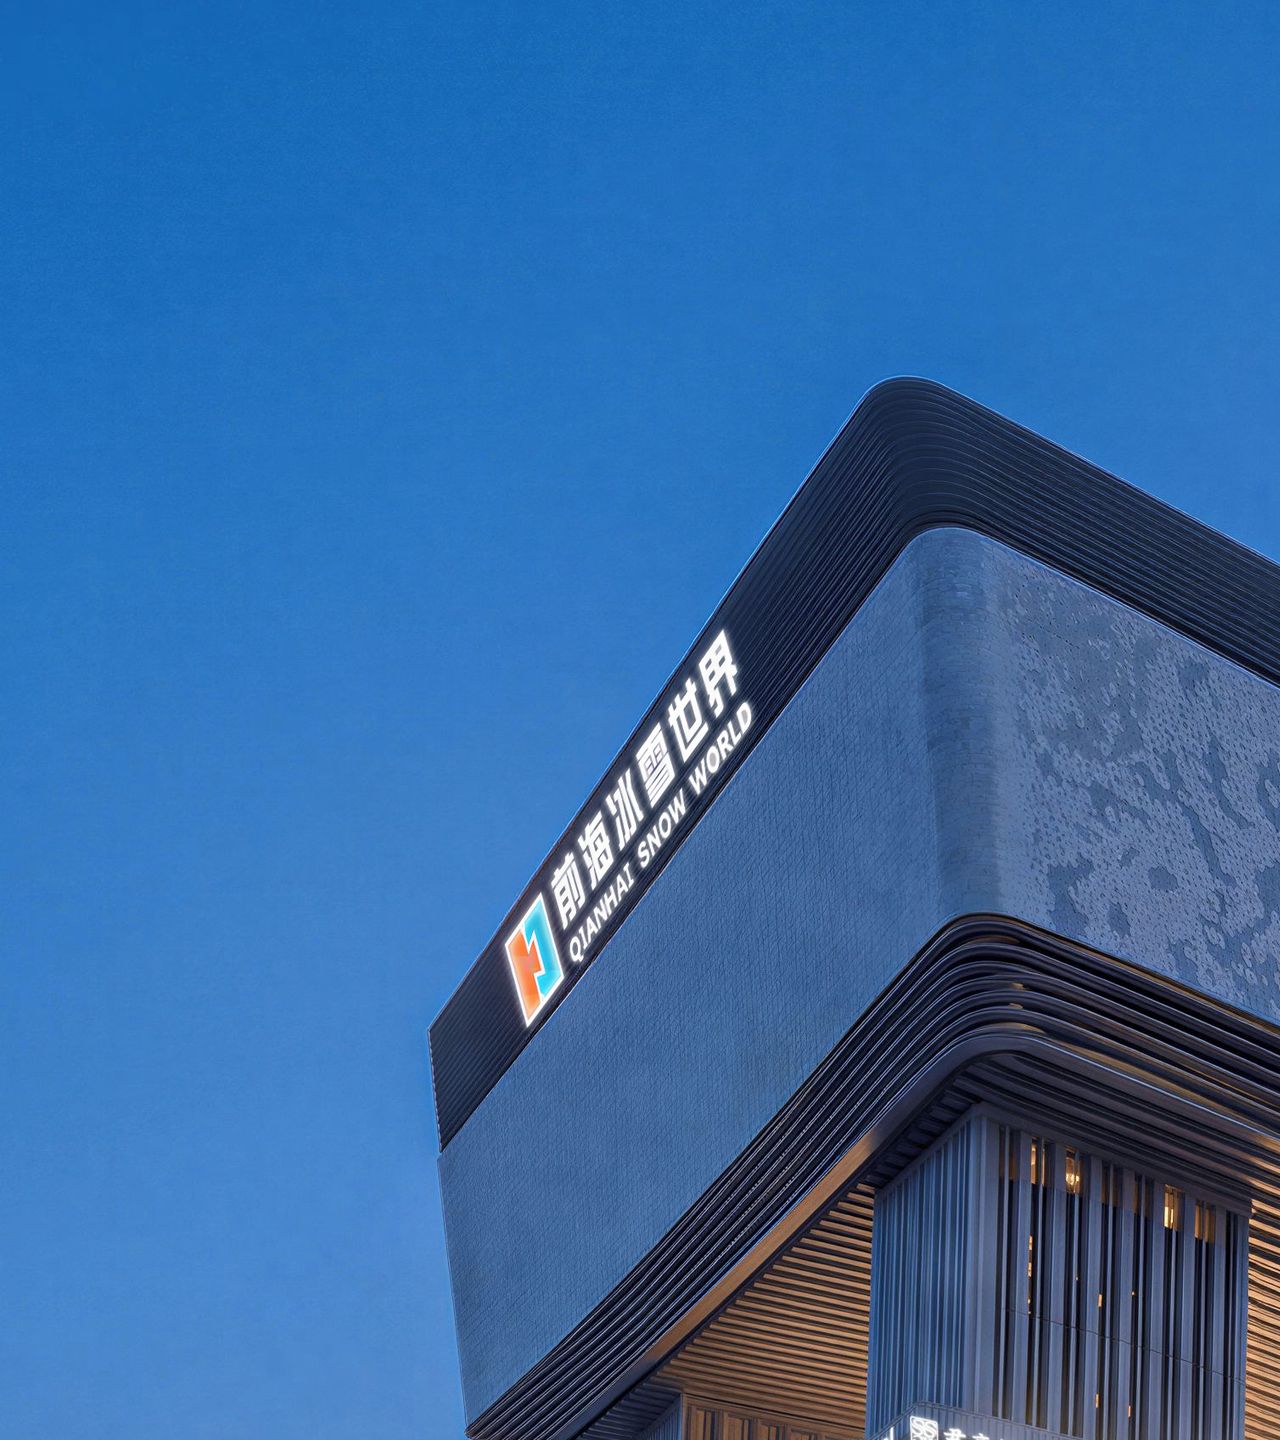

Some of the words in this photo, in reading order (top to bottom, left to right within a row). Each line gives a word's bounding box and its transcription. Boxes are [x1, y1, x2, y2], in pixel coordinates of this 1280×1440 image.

[550, 629, 738, 931] 前海冰雪世界
[569, 862, 635, 963] QIANHAI
[637, 787, 686, 870] SNOW
[688, 702, 752, 795] WORLD
